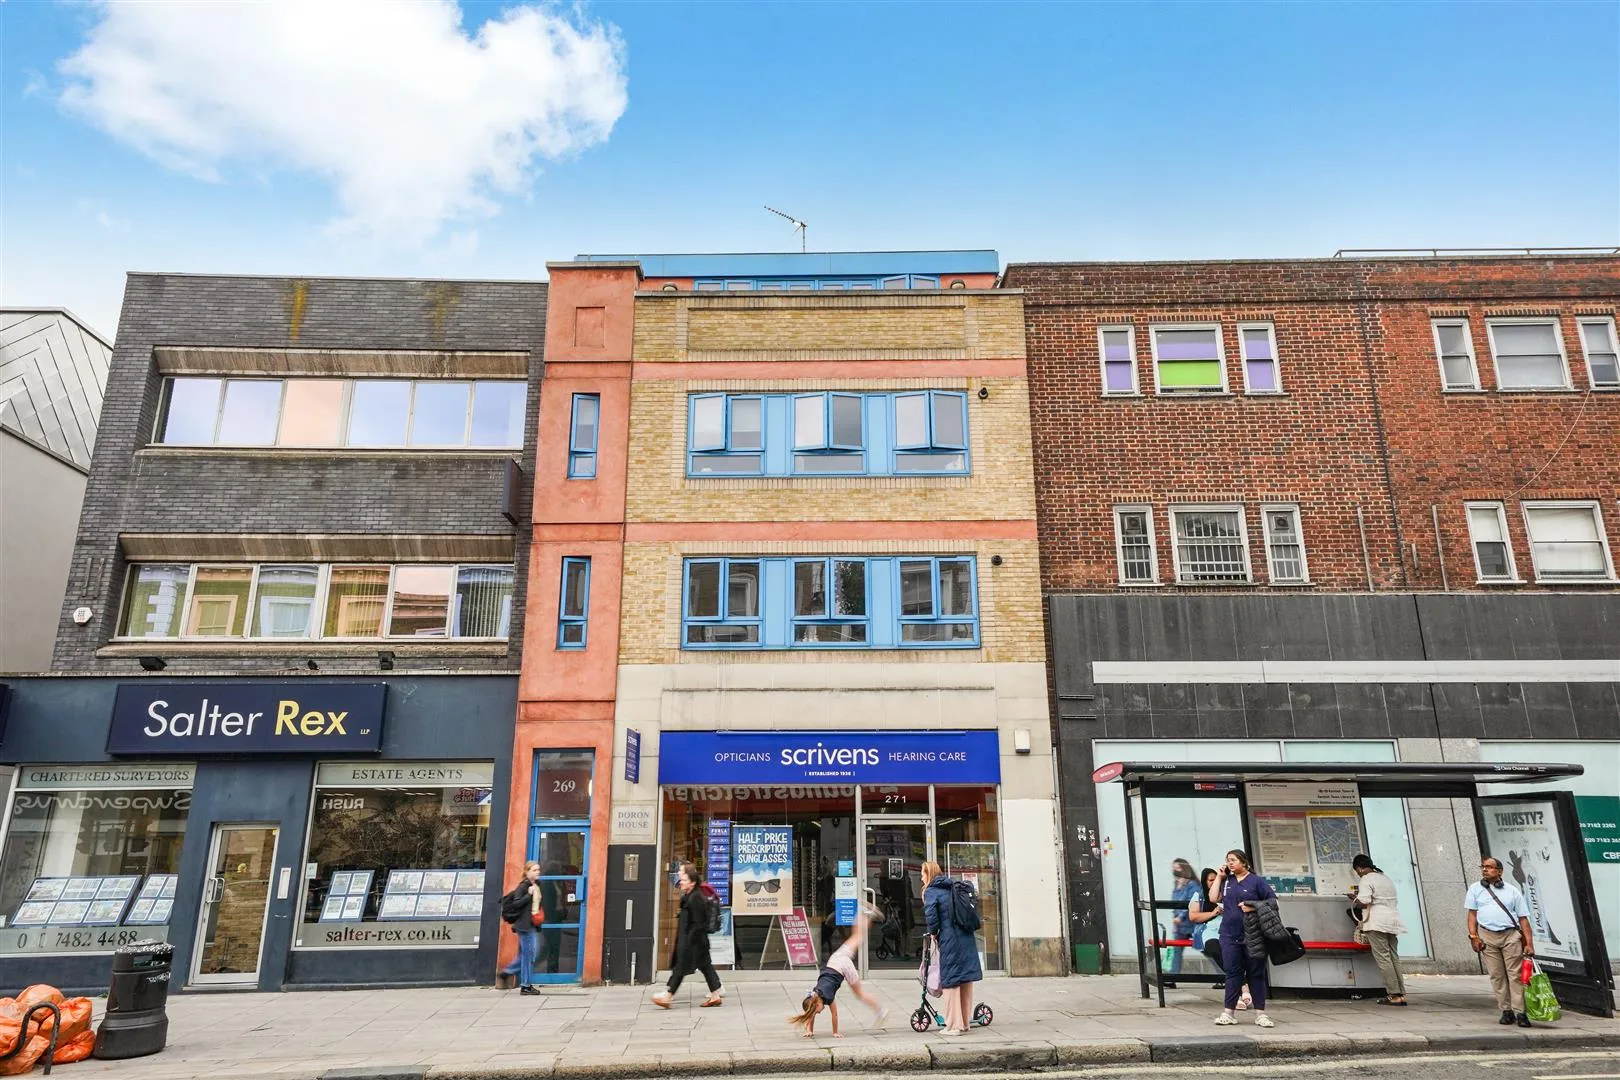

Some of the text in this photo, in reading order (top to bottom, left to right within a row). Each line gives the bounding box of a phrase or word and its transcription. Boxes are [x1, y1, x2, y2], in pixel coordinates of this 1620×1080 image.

[144, 699, 263, 737] Salter
[274, 700, 348, 736] Rex
[714, 742, 967, 766] OPTICIANS scrivens HEARING CARE
[30, 770, 189, 783] CHARTERED SURVEYORS
[352, 769, 463, 780] ESTATE AGENTS
[553, 780, 576, 793] 269
[885, 795, 906, 803] 271
[1494, 811, 1544, 826] THIRSTY?
[738, 833, 788, 844] HALF PRICE
[738, 844, 788, 853] PRESCRIPTION
[738, 854, 788, 863] SUNGLASSES
[55, 932, 92, 947] 7482
[97, 930, 138, 947] 4488
[325, 926, 452, 942] salter-rex.co.uk
